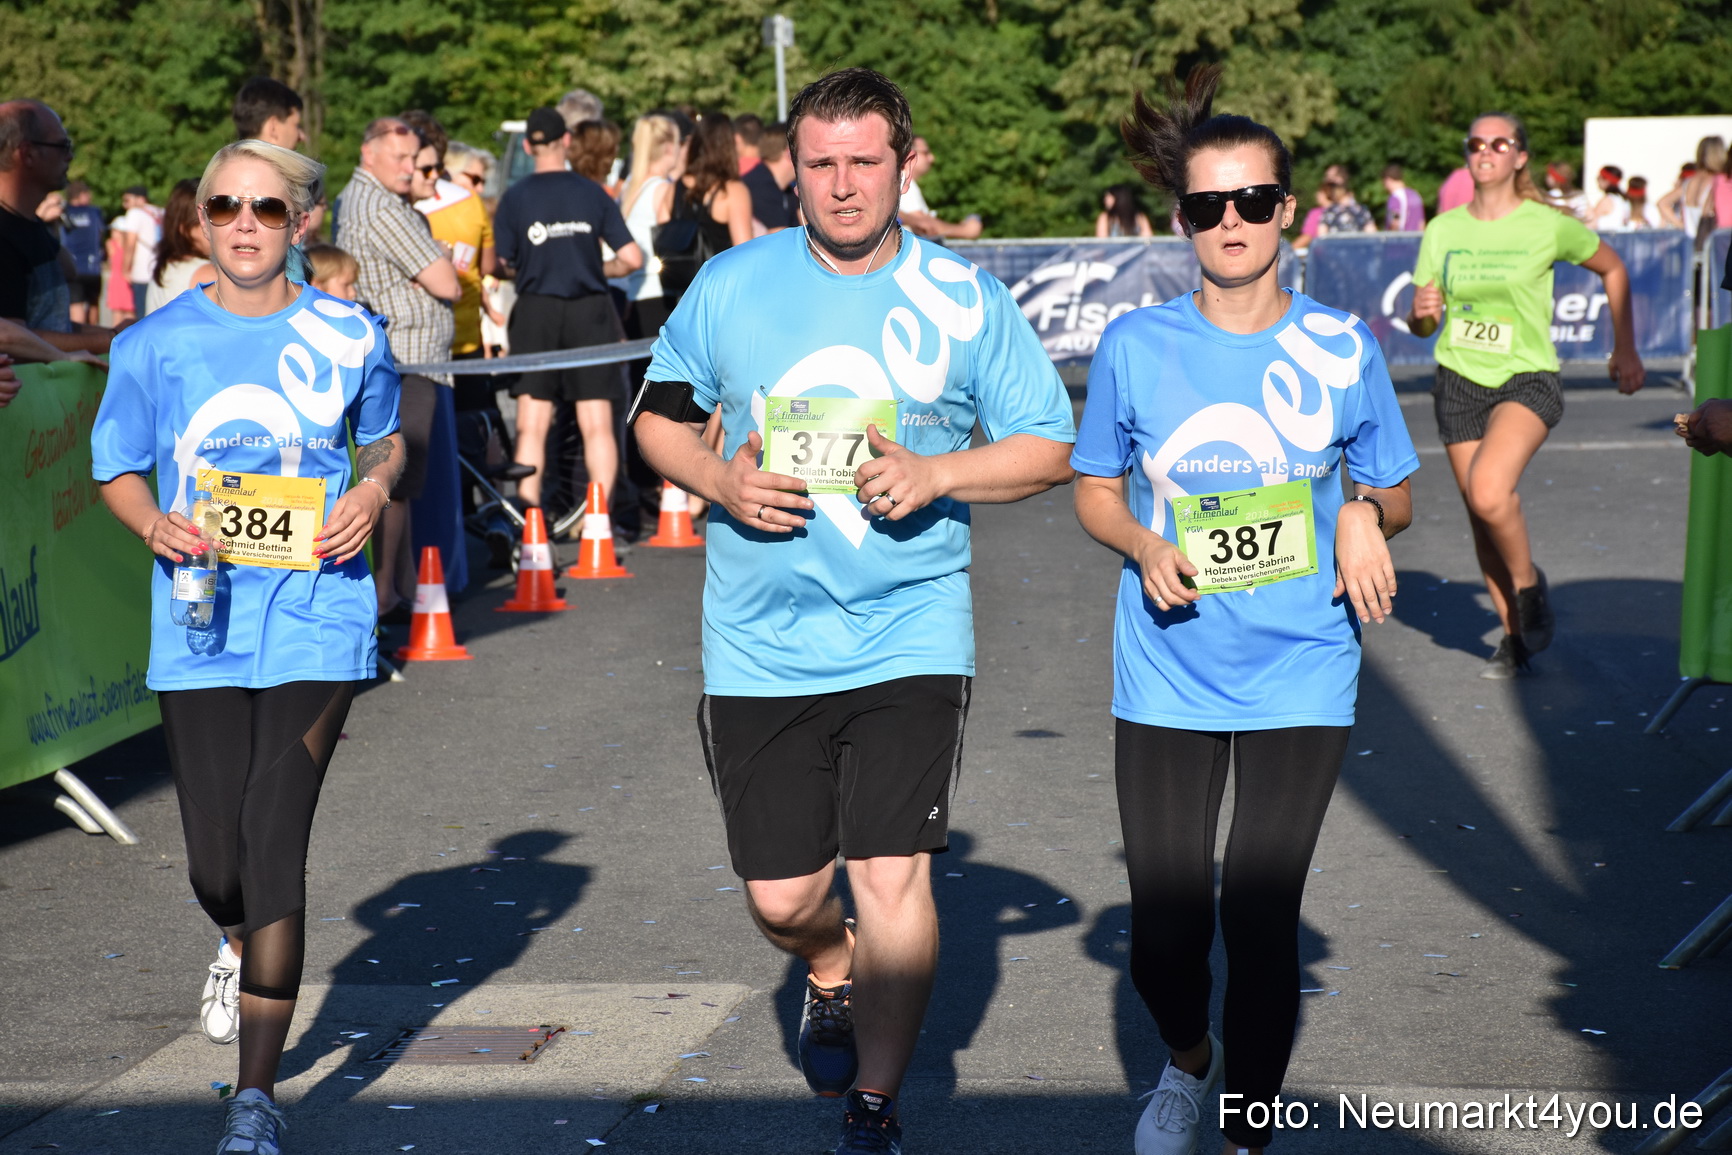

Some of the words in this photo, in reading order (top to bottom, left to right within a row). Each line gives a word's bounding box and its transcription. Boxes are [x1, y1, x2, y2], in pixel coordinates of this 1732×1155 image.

[1464, 320, 1500, 341] 720
[782, 411, 825, 421] firmenlauf
[203, 433, 271, 450] anders
[278, 433, 301, 448] als
[791, 431, 864, 466] 377
[793, 467, 826, 477] Pöllath
[830, 469, 857, 478] Tobia
[1176, 455, 1252, 473] anders
[1260, 456, 1288, 475] als
[1293, 460, 1331, 478] ande
[814, 478, 854, 486] Versicherun
[213, 485, 257, 497] firmenlauf
[1193, 506, 1239, 519] firmenlauf
[1245, 510, 1269, 521] 2018
[220, 505, 293, 542] 384
[219, 538, 255, 550] Schmid
[258, 543, 293, 553] Bettina
[1208, 520, 1283, 564] 387
[242, 551, 293, 561] Versicherungen
[1204, 563, 1256, 576] Holzmeier
[1258, 555, 1295, 569] Sabrina
[1211, 576, 1238, 584] Debeka
[1239, 565, 1291, 581] Versicherungen
